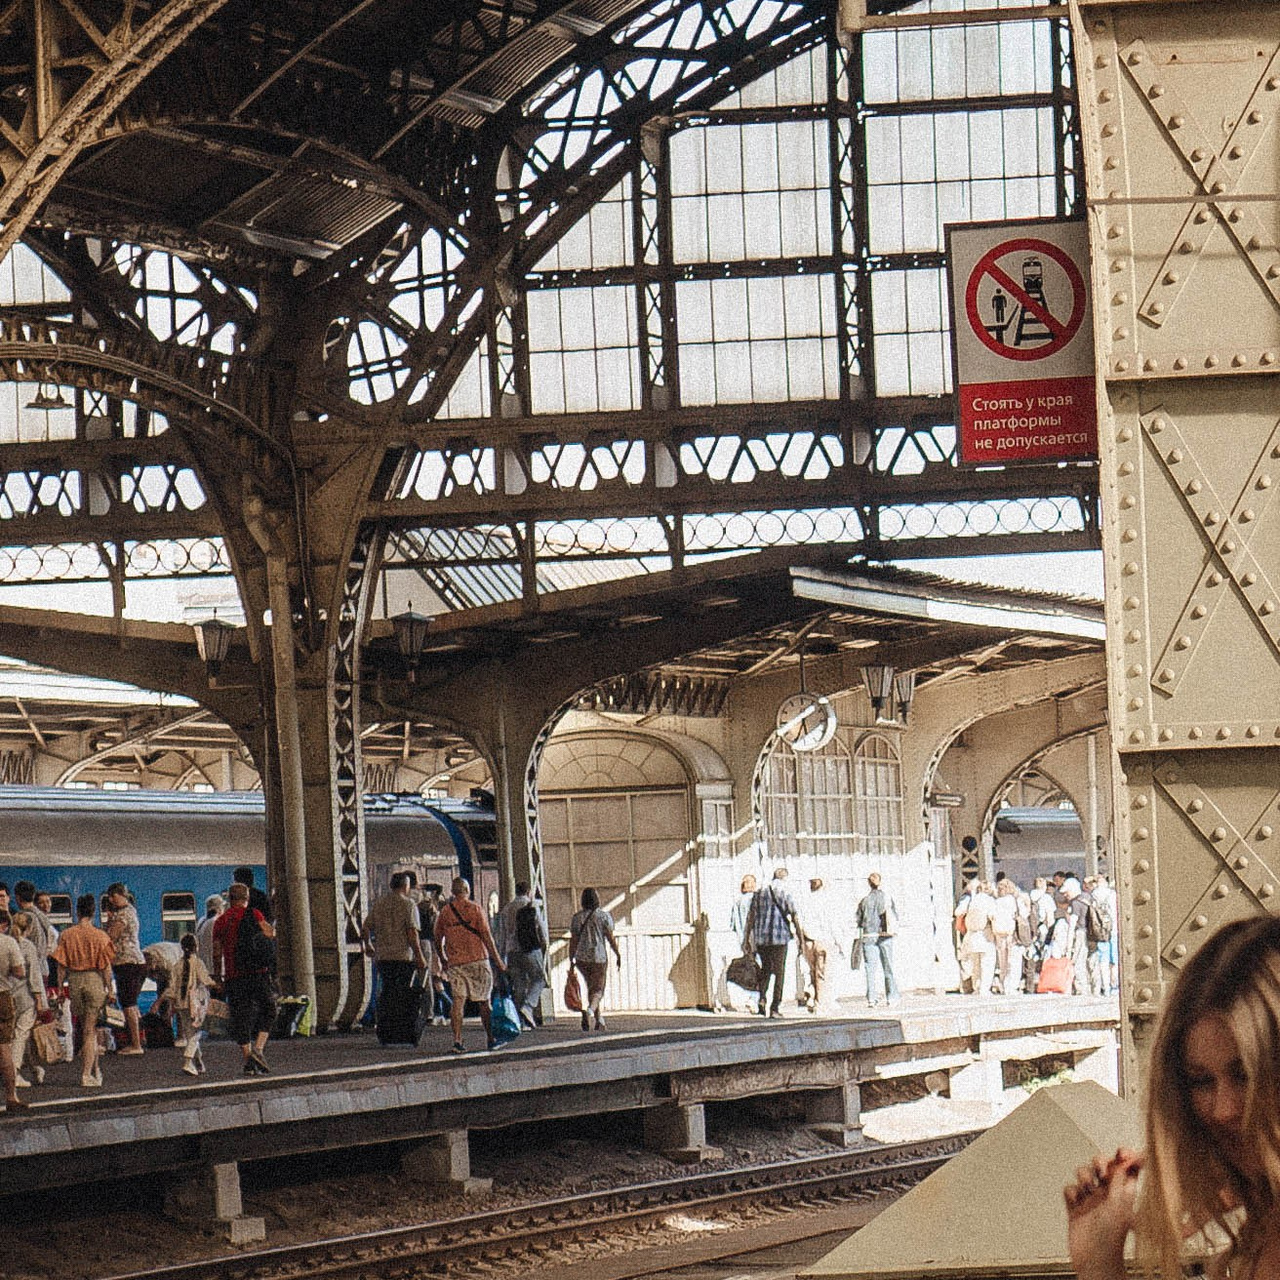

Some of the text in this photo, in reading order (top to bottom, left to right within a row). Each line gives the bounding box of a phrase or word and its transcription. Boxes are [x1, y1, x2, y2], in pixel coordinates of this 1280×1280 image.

[972, 395, 1073, 411] Стоять у края
[973, 415, 1061, 432] платформы
[975, 433, 1088, 450] не допускается
